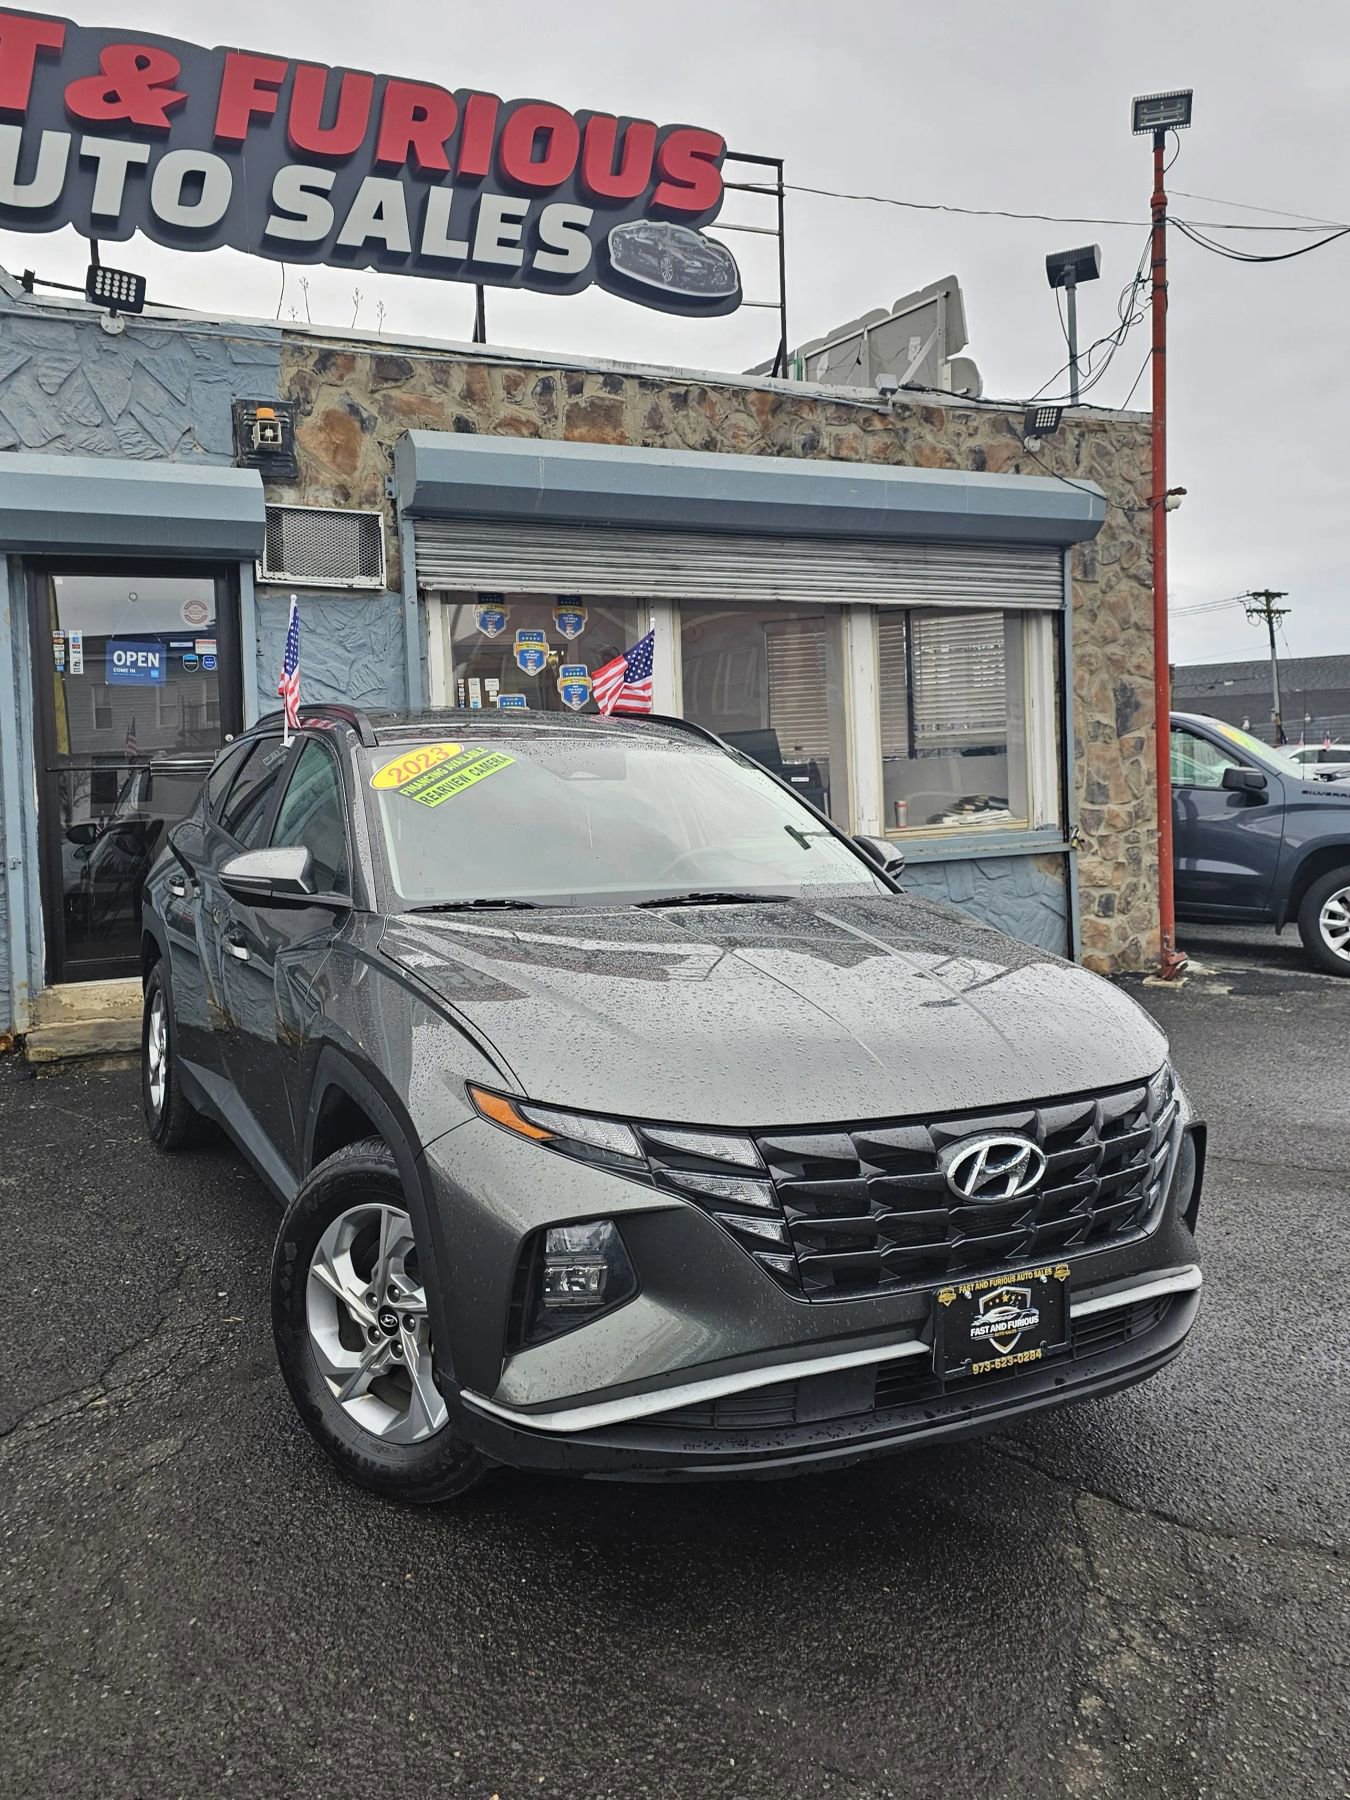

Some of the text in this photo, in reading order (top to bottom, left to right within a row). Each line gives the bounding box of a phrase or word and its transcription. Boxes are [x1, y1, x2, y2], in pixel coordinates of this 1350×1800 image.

[64, 43, 189, 129] &
[213, 51, 725, 212] FURIOUS
[264, 163, 594, 275] SALES
[113, 650, 160, 667] OPEN
[388, 746, 450, 784] 2023
[401, 745, 488, 796] FINANCING AVAILABLE
[419, 754, 510, 805] REARVIEW CAMERA
[959, 1267, 1052, 1293] FAST AND FURIOUS AUTO SALES
[970, 1316, 1039, 1337] FAST AND FURIOUS
[973, 1349, 1042, 1374] 973-623-0284
